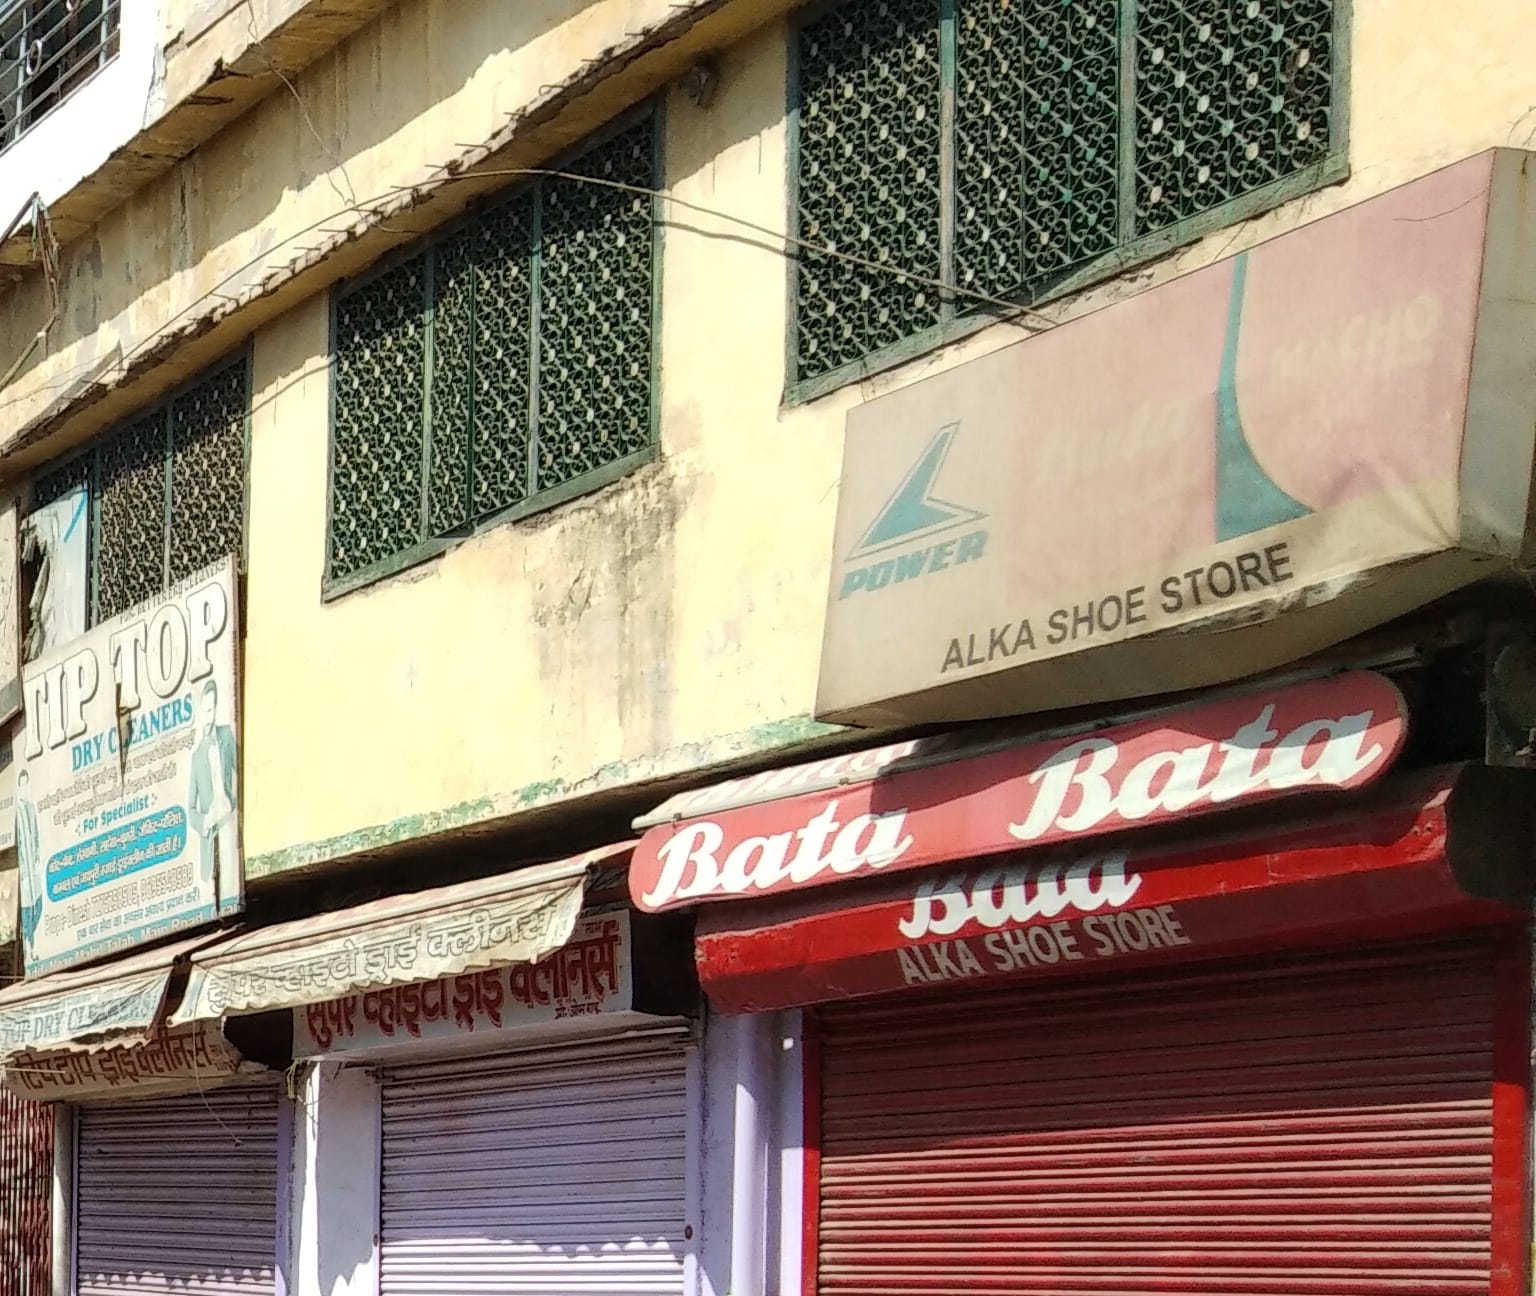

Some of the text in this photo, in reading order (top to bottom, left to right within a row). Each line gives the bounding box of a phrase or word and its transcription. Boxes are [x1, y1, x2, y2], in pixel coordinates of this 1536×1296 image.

[838, 529, 990, 601] POWER
[940, 541, 1295, 674] ALKA SHOE STORE
[24, 647, 100, 762] TIP
[109, 581, 228, 711] TOP
[71, 692, 194, 773] DRY CEANERS
[1008, 702, 1391, 841] Bata
[83, 791, 149, 835] For Specialist
[640, 802, 917, 909] Bata
[896, 905, 1193, 986] ALKA SHOE STORE
